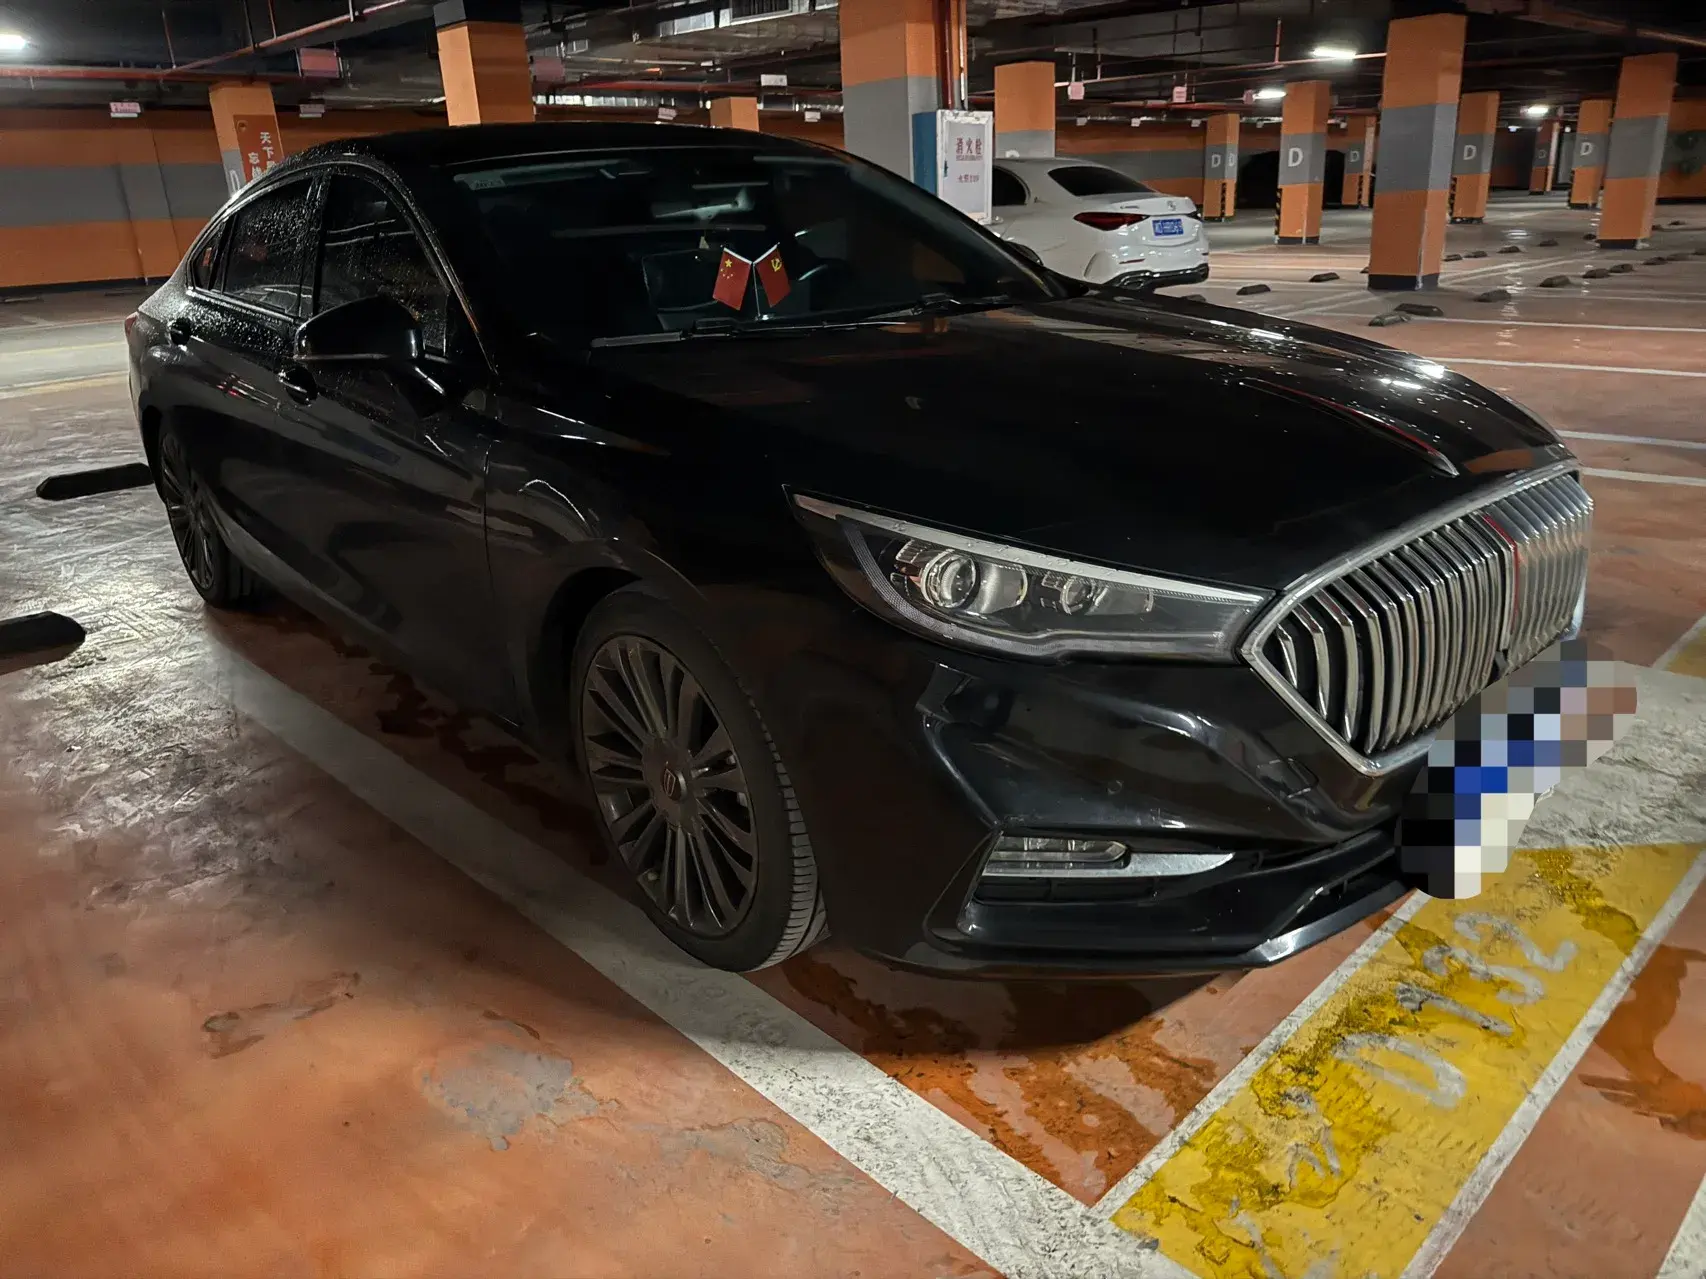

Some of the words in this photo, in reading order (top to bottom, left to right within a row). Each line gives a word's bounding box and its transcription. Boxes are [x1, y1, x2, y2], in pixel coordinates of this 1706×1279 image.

[956, 137, 982, 155] 消火栓
[1463, 145, 1477, 160] D
[1580, 141, 1594, 155] D
[1211, 154, 1221, 168] D
[1228, 152, 1236, 166] D
[1288, 147, 1303, 167] D
[1351, 150, 1360, 162] D
